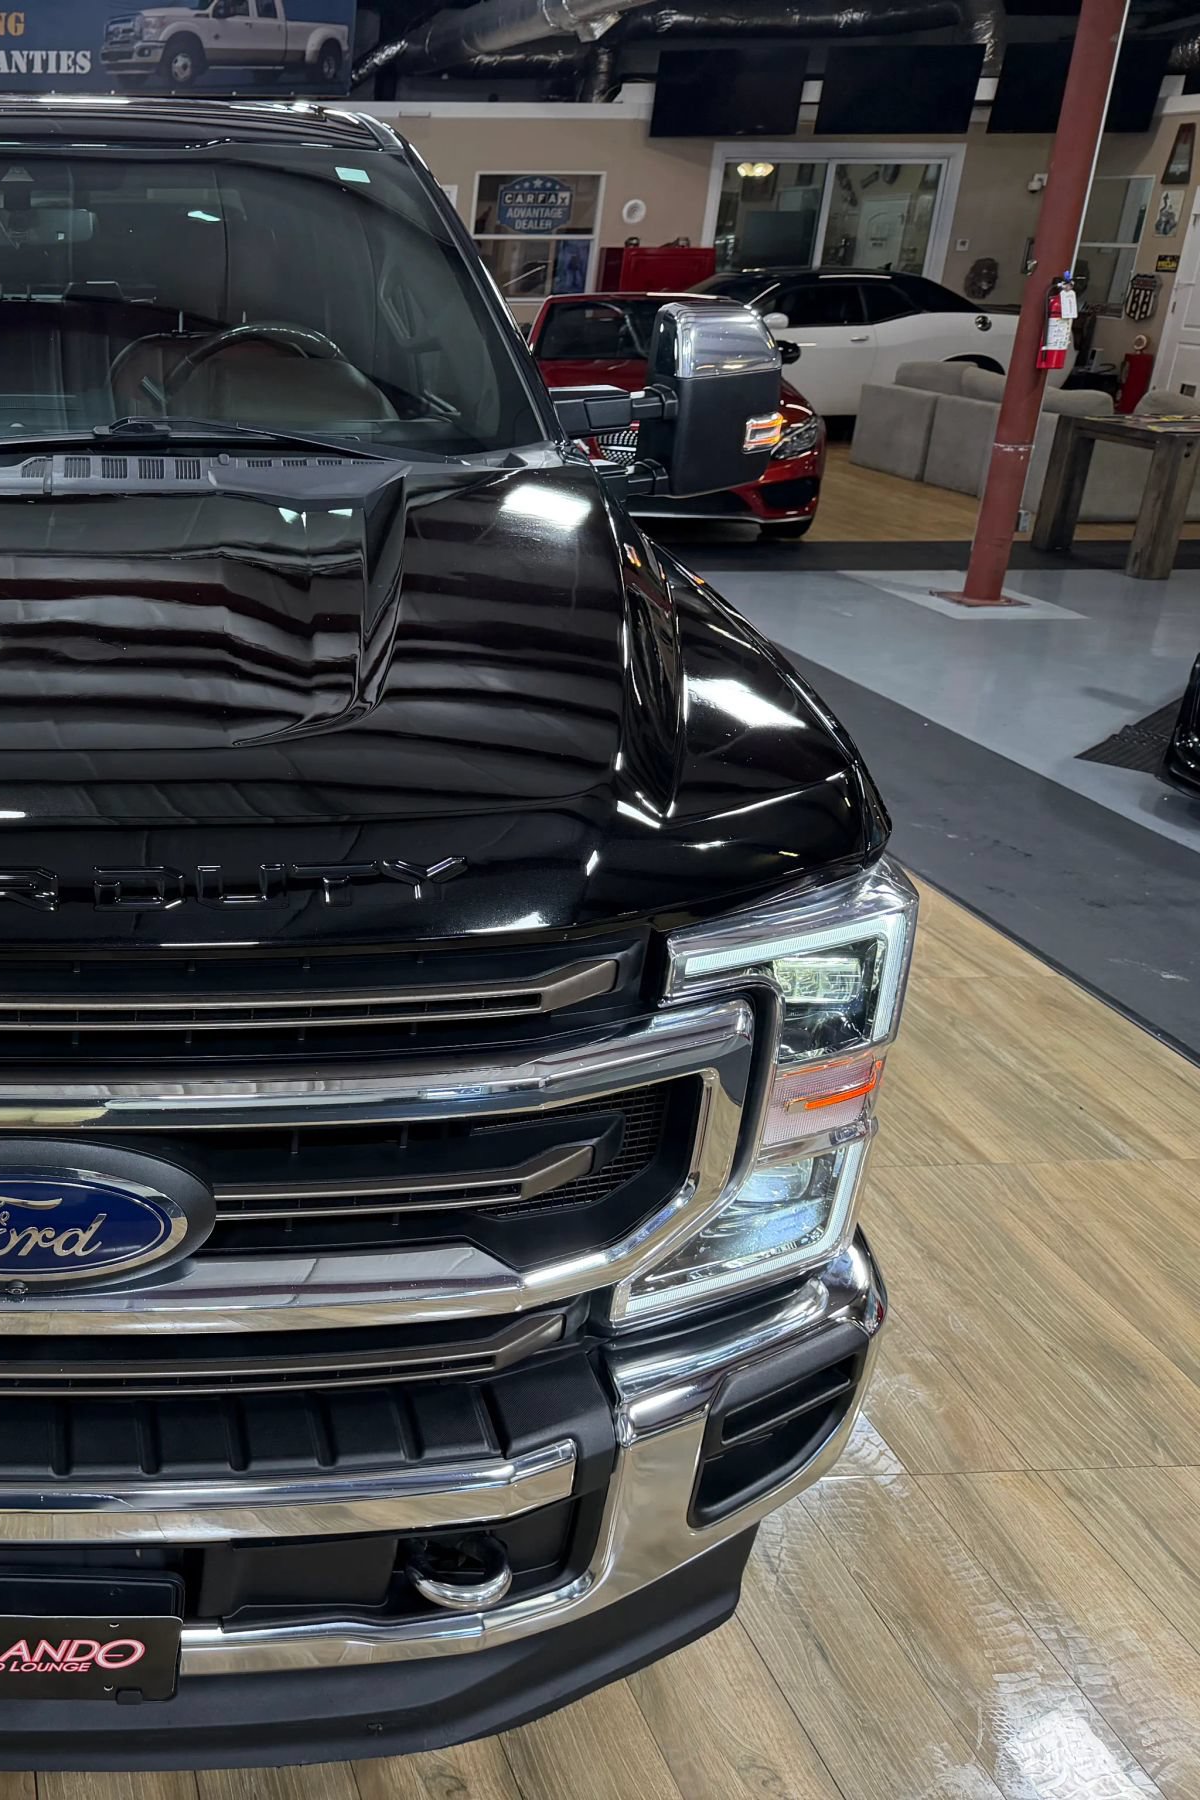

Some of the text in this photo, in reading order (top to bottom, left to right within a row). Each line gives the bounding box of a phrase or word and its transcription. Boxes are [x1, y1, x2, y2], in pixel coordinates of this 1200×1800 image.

[504, 192, 570, 206] CARFAX
[506, 208, 563, 218] ADVANTAGE
[514, 219, 553, 230] DEALER
[93, 855, 469, 913] DUTY
[9, 1660, 91, 1673] LOUNGE
